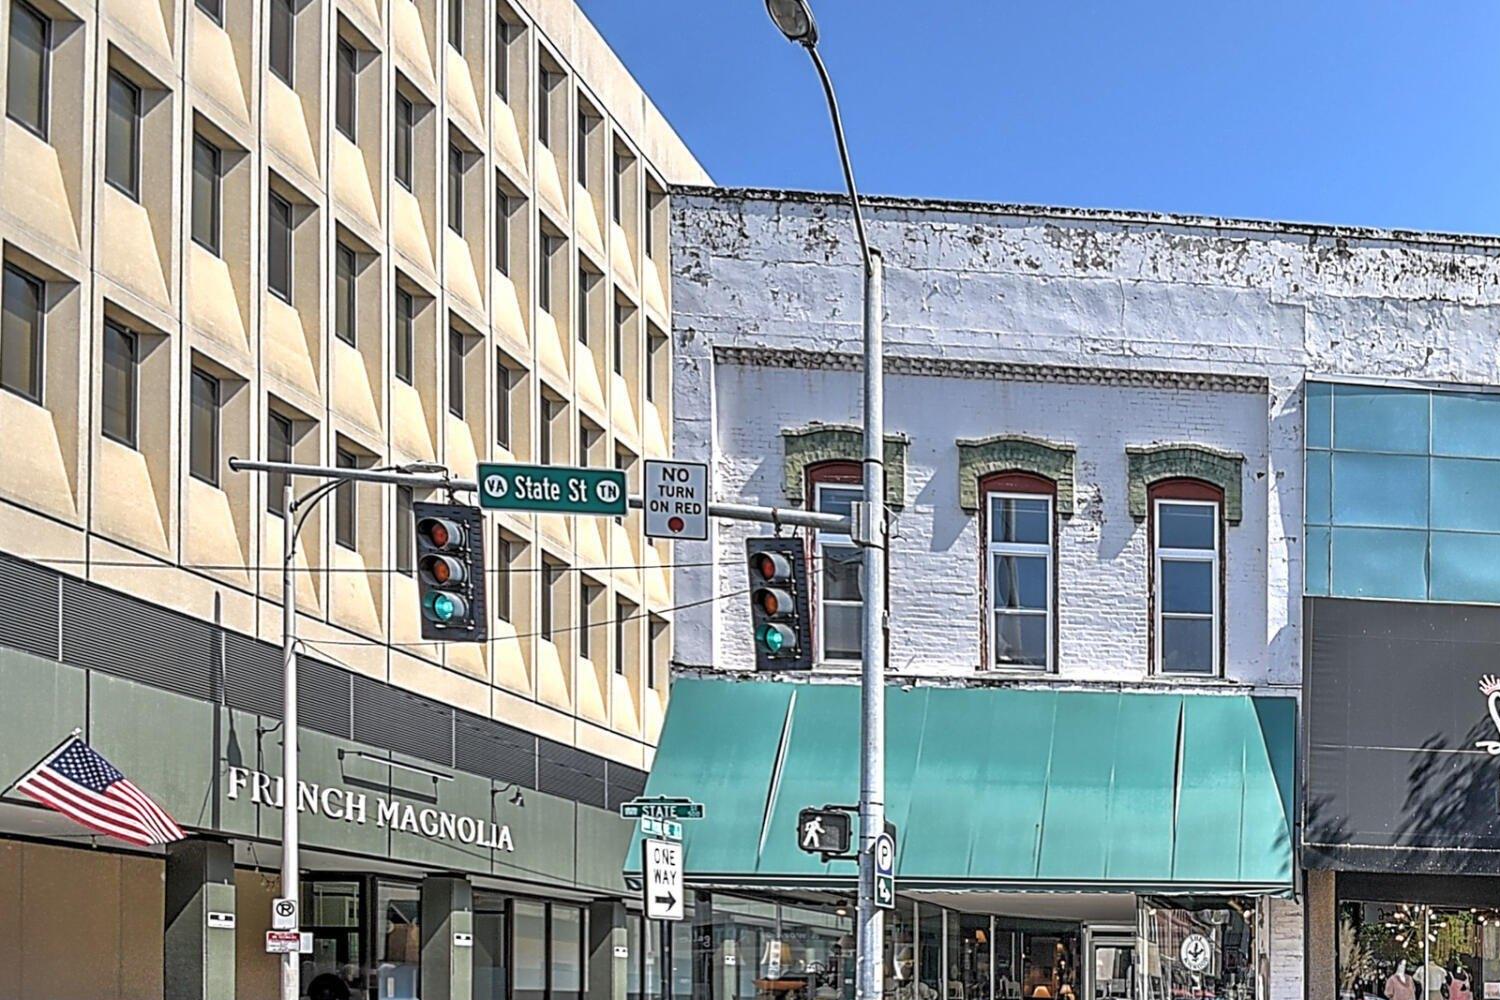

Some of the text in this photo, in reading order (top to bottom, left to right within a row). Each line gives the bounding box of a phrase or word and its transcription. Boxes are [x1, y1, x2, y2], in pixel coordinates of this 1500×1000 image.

[662, 467, 689, 482] NO
[487, 475, 617, 502] VA State St TN
[658, 485, 694, 498] TURN
[650, 501, 701, 514] ON RED
[642, 805, 677, 817] STATE
[376, 798, 514, 851] MAGNOLIA
[654, 848, 676, 866] ONE
[654, 869, 677, 886] WAY
